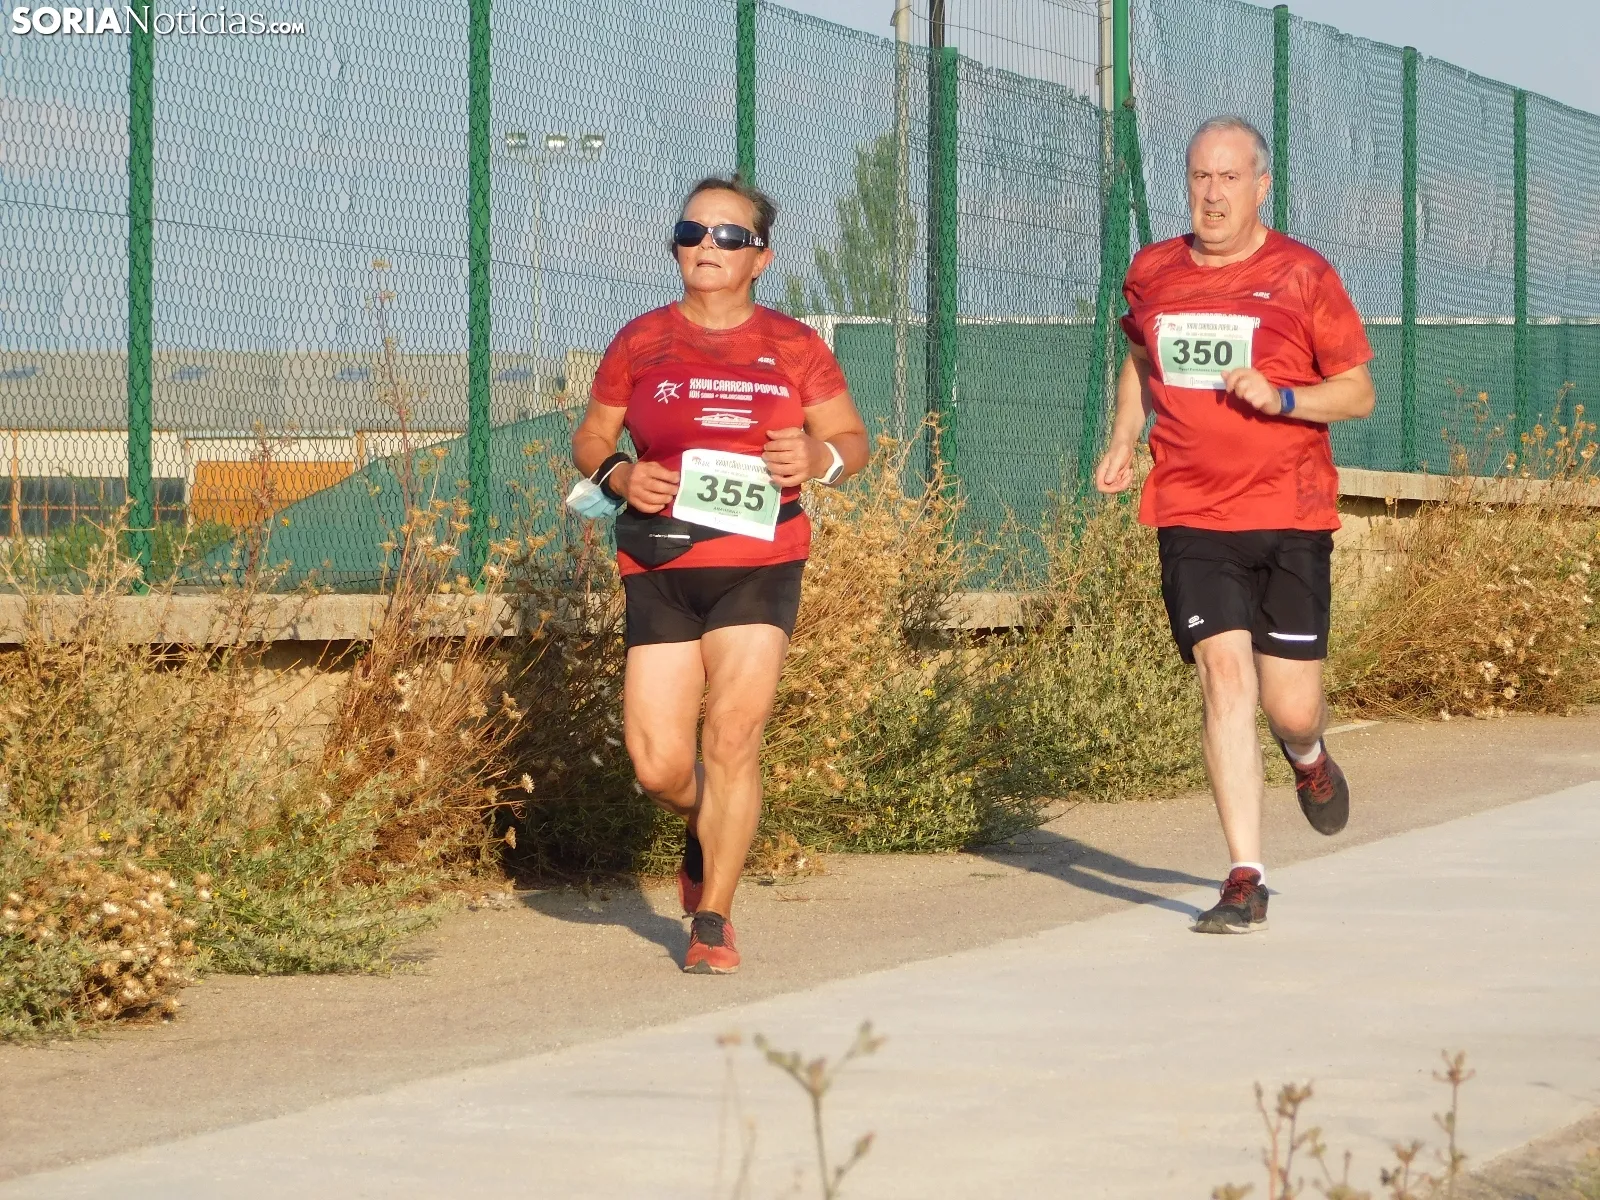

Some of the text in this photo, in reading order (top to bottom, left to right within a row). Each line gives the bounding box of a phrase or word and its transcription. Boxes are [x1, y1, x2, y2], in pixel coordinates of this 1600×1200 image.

[1172, 339, 1233, 366] 350
[713, 379, 754, 393] CARRERA
[754, 383, 790, 398] POPULAR
[696, 474, 766, 512] 355
